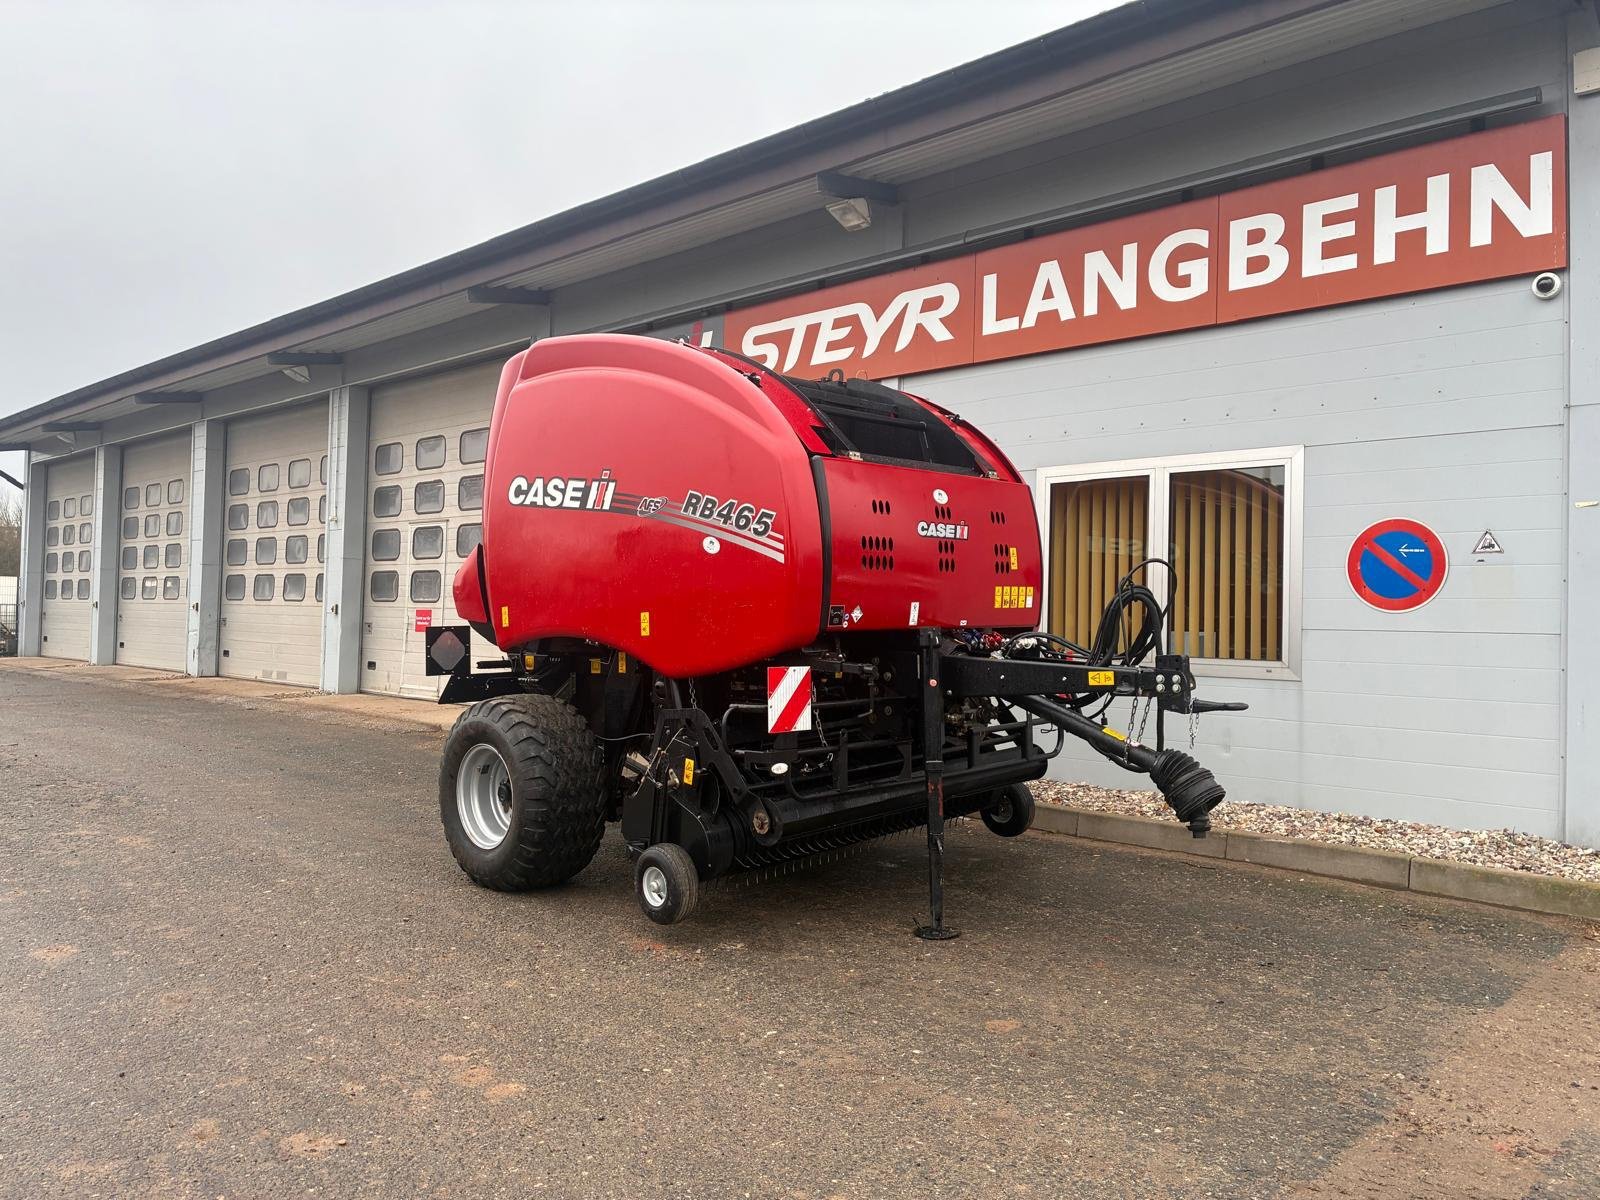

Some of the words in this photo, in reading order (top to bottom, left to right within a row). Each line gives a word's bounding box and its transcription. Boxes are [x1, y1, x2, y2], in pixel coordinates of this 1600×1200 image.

[741, 282, 960, 374] STEYR
[981, 150, 1554, 336] LANGBEHN
[508, 476, 586, 508] CASE
[638, 496, 662, 513] AFS
[681, 489, 777, 538] RB465
[917, 521, 956, 538] CASE
